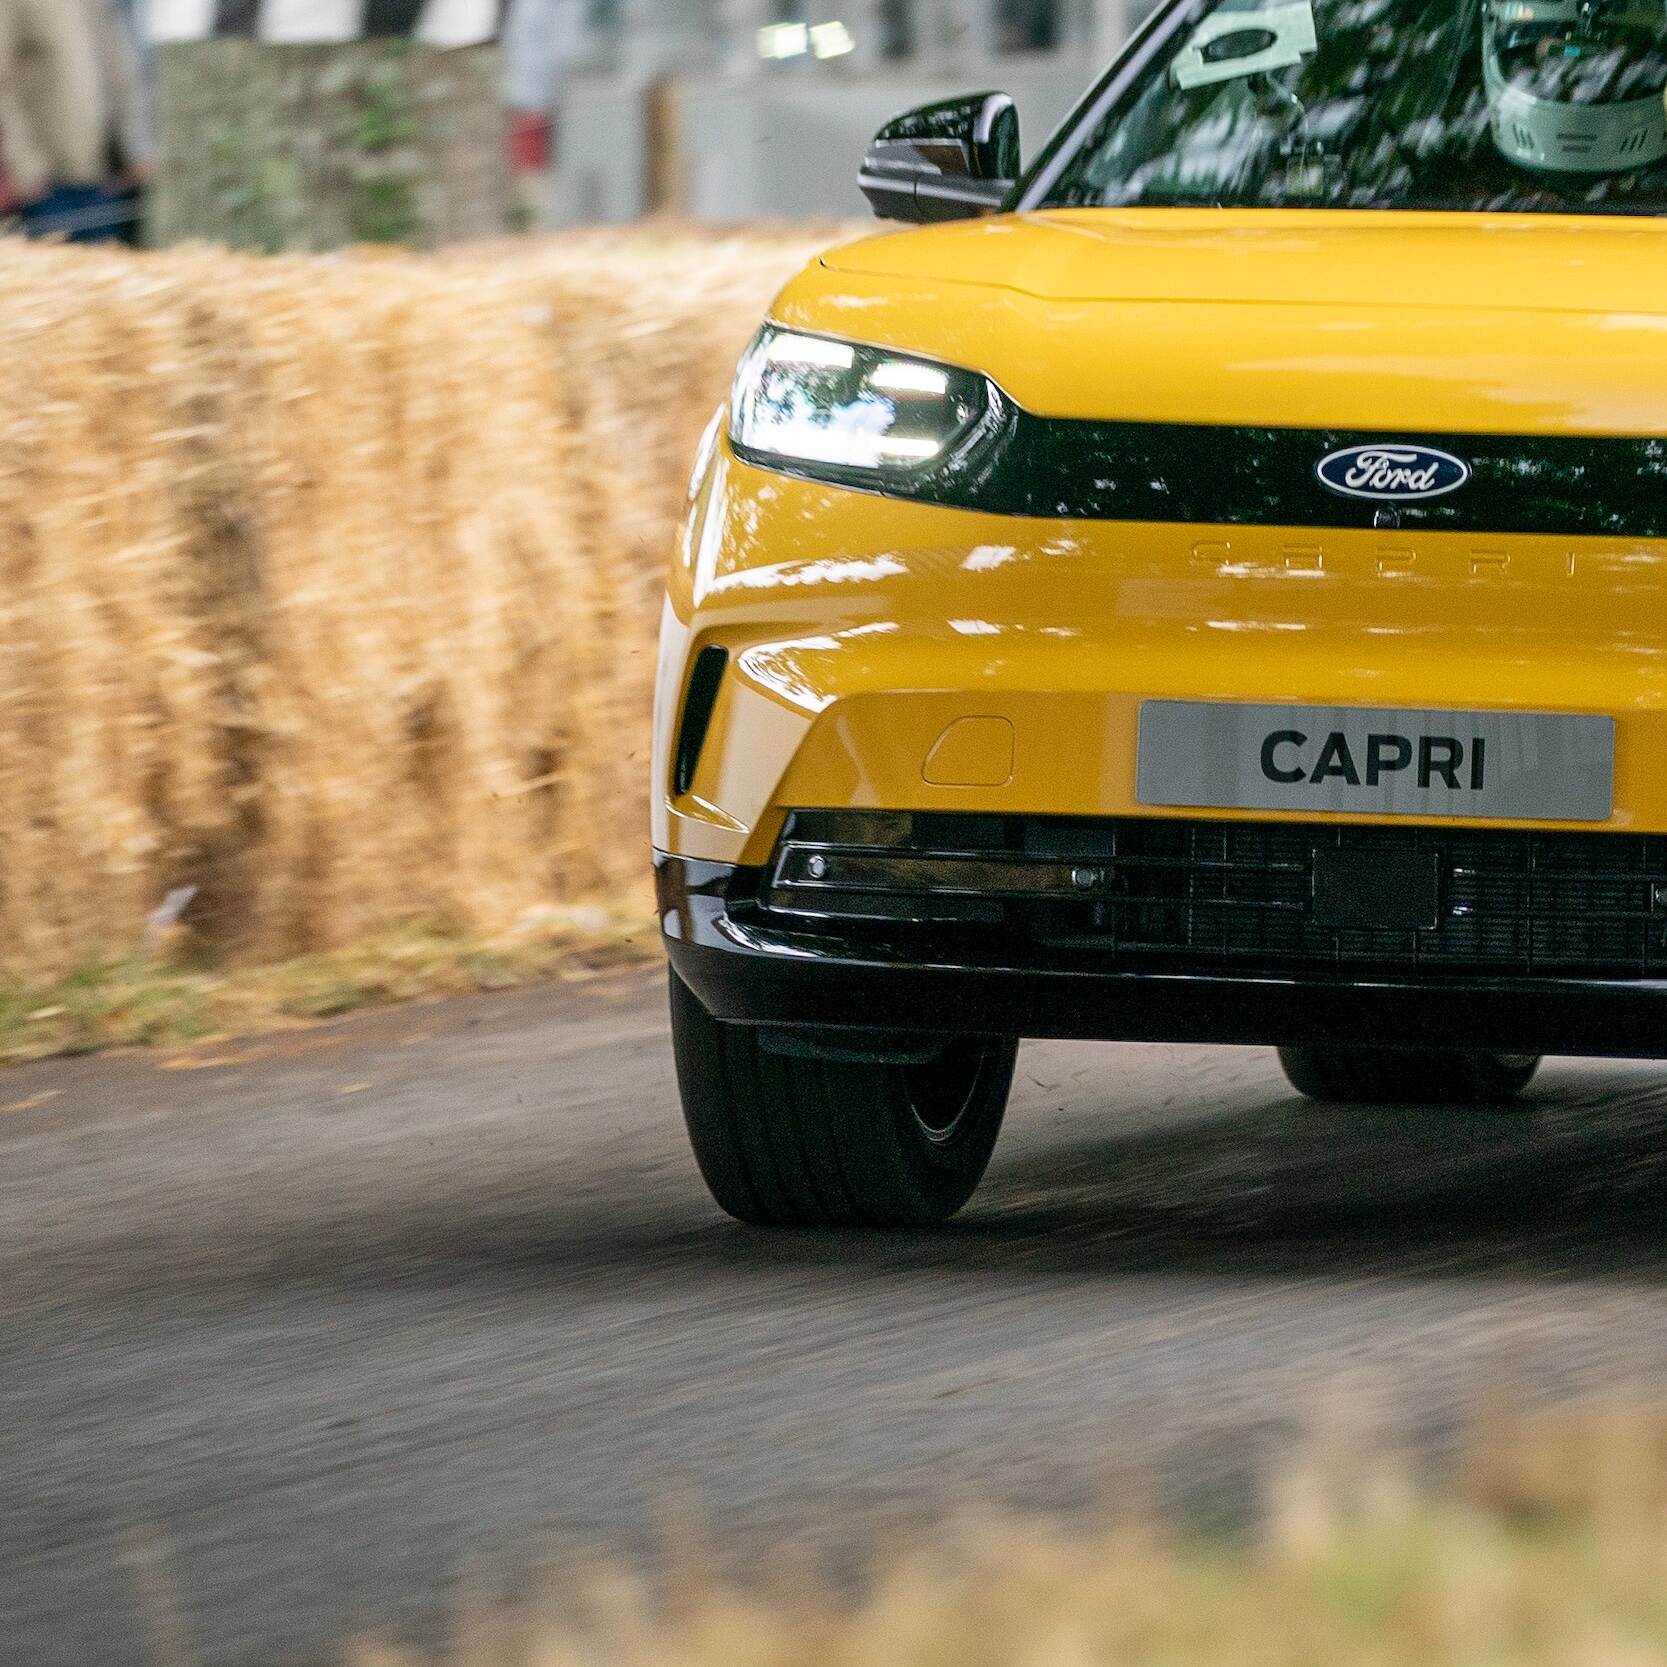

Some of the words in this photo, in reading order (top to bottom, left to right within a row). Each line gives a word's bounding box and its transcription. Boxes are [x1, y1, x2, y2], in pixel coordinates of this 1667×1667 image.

[1345, 450, 1439, 491] Ford
[1190, 540, 1576, 577] CAPRI
[1260, 729, 1486, 791] CAPRI
